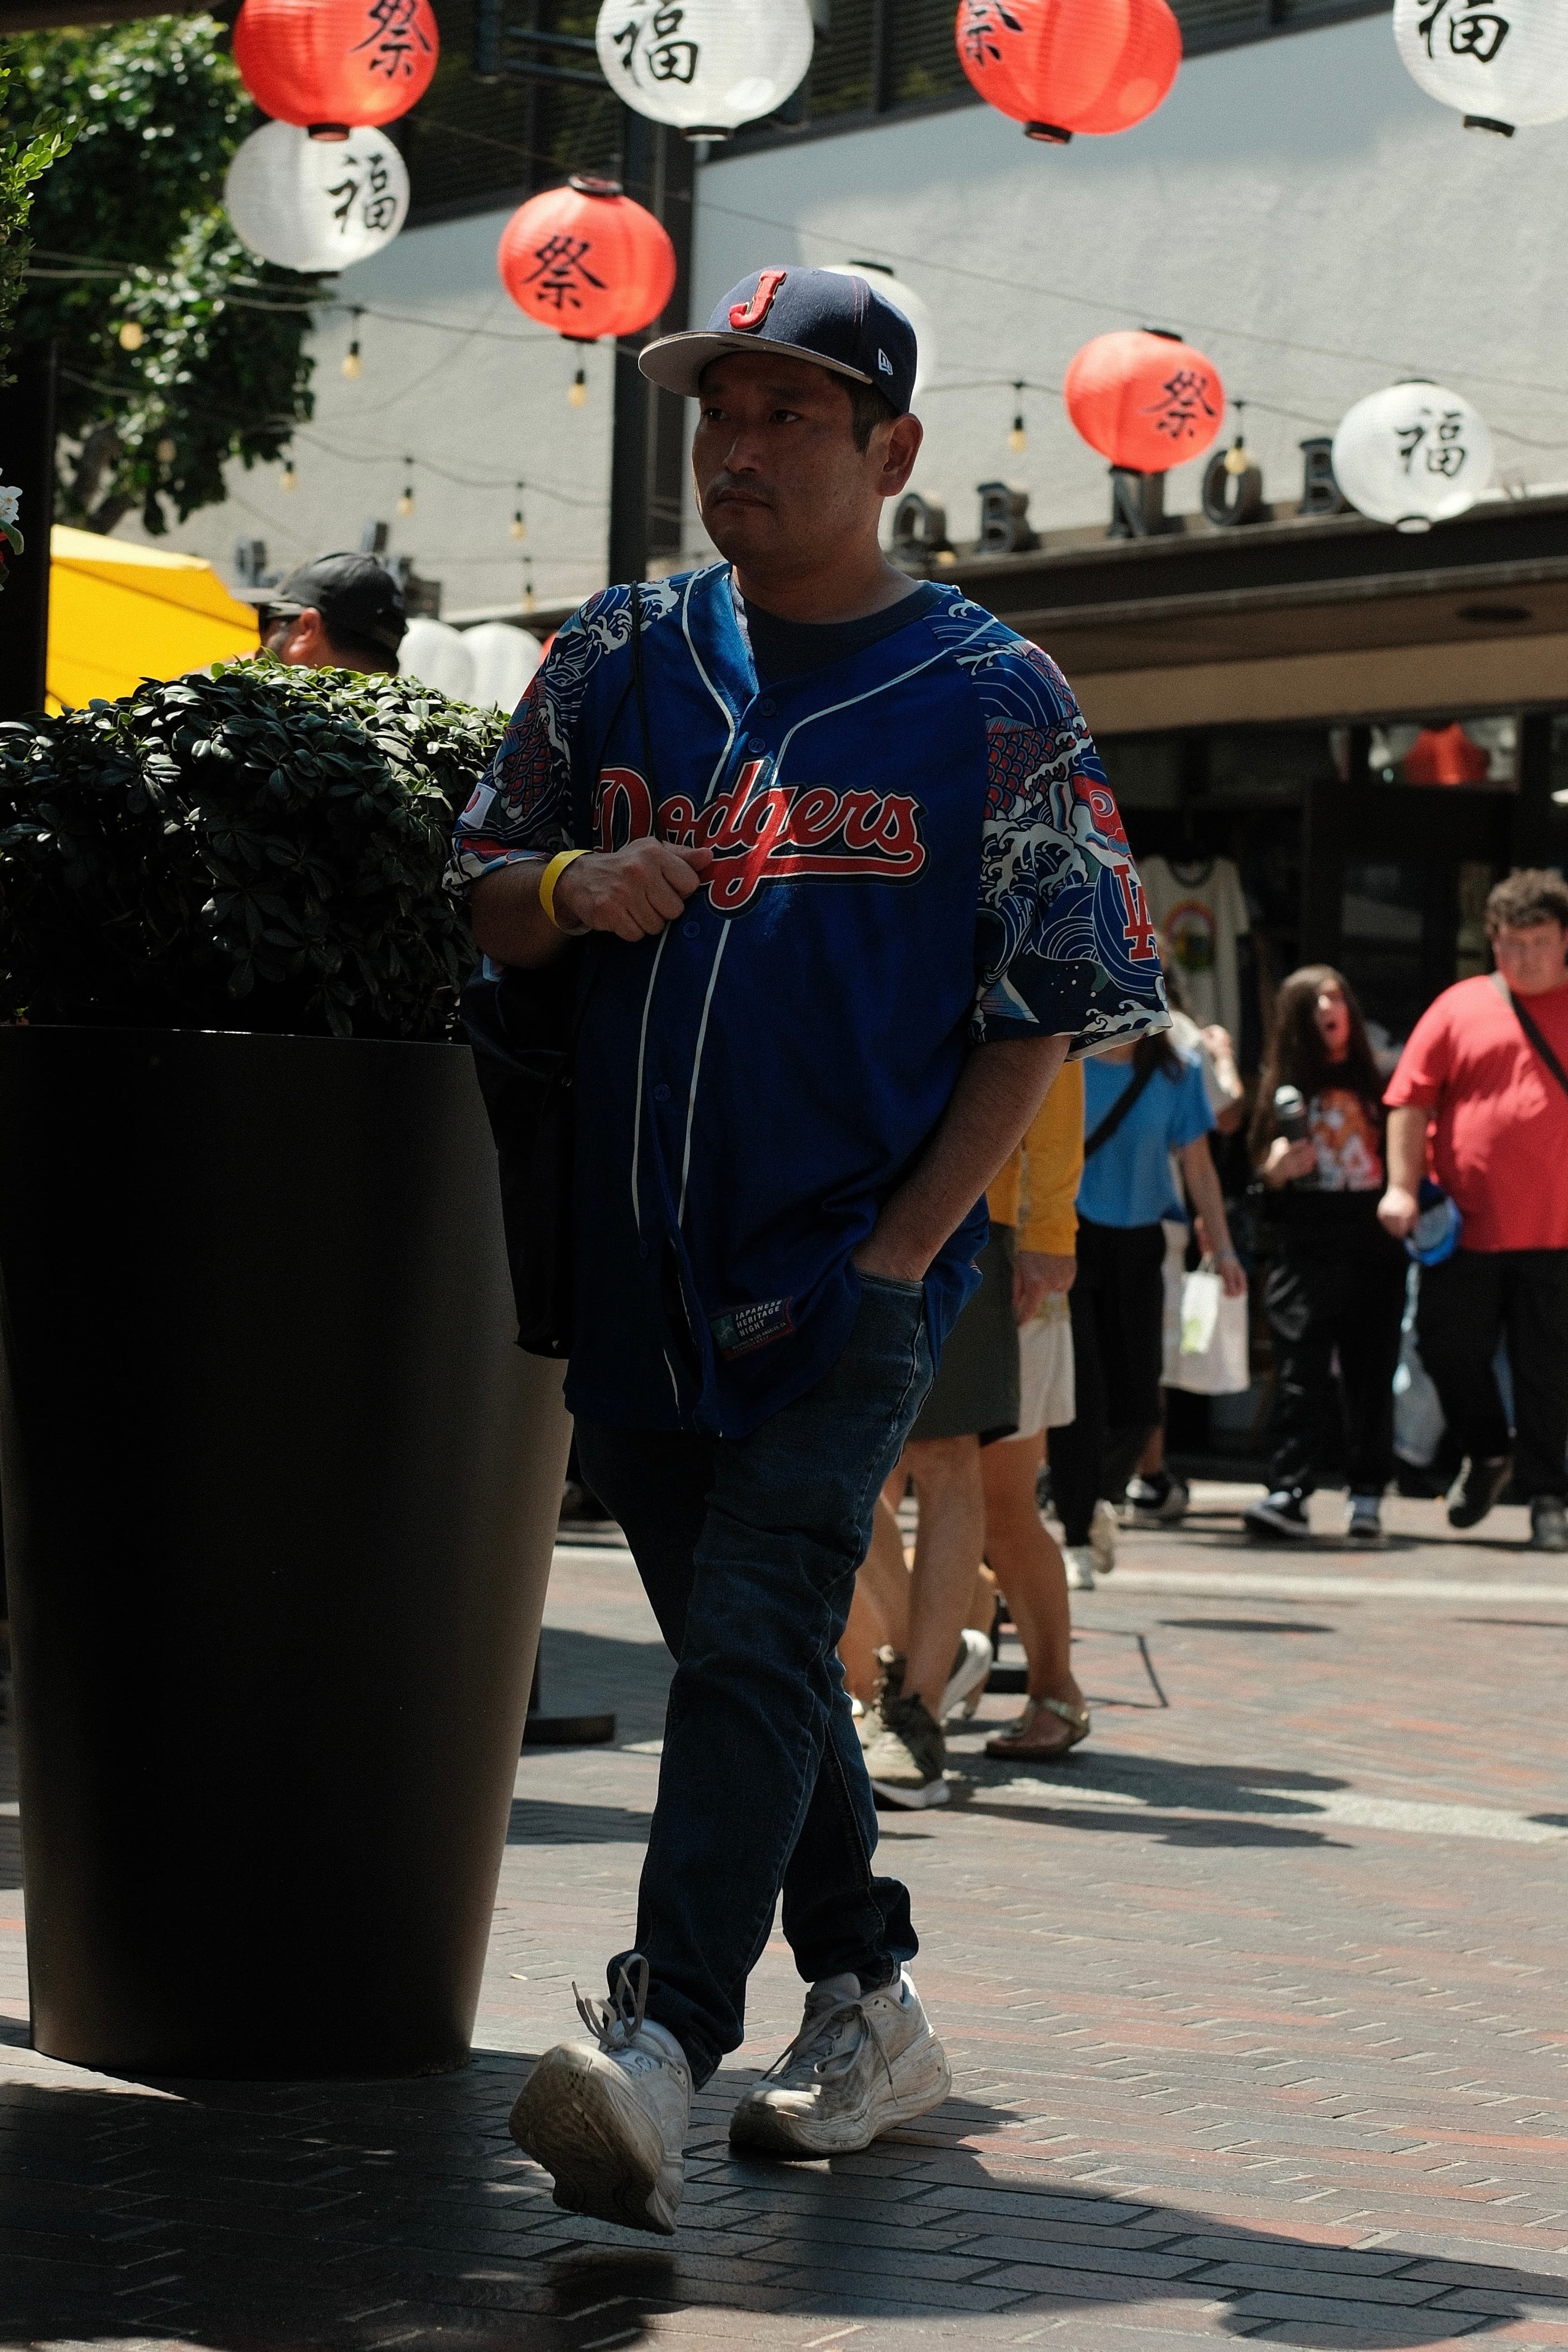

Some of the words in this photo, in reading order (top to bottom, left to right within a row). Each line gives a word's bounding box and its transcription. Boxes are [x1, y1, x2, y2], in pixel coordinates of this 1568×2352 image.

[349, 0, 431, 78] 祭
[614, 0, 698, 87] 福
[329, 153, 396, 234] 福
[525, 235, 607, 310] 祭
[728, 270, 787, 332] J
[1139, 371, 1215, 438] 祭
[1394, 407, 1466, 477] 福
[591, 757, 926, 911] Dodgers
[1113, 864, 1155, 962] LA
[735, 1300, 782, 1321] JAPANESE
[737, 1305, 780, 1329] HERITAGE
[739, 1319, 765, 1336] NIGHT
